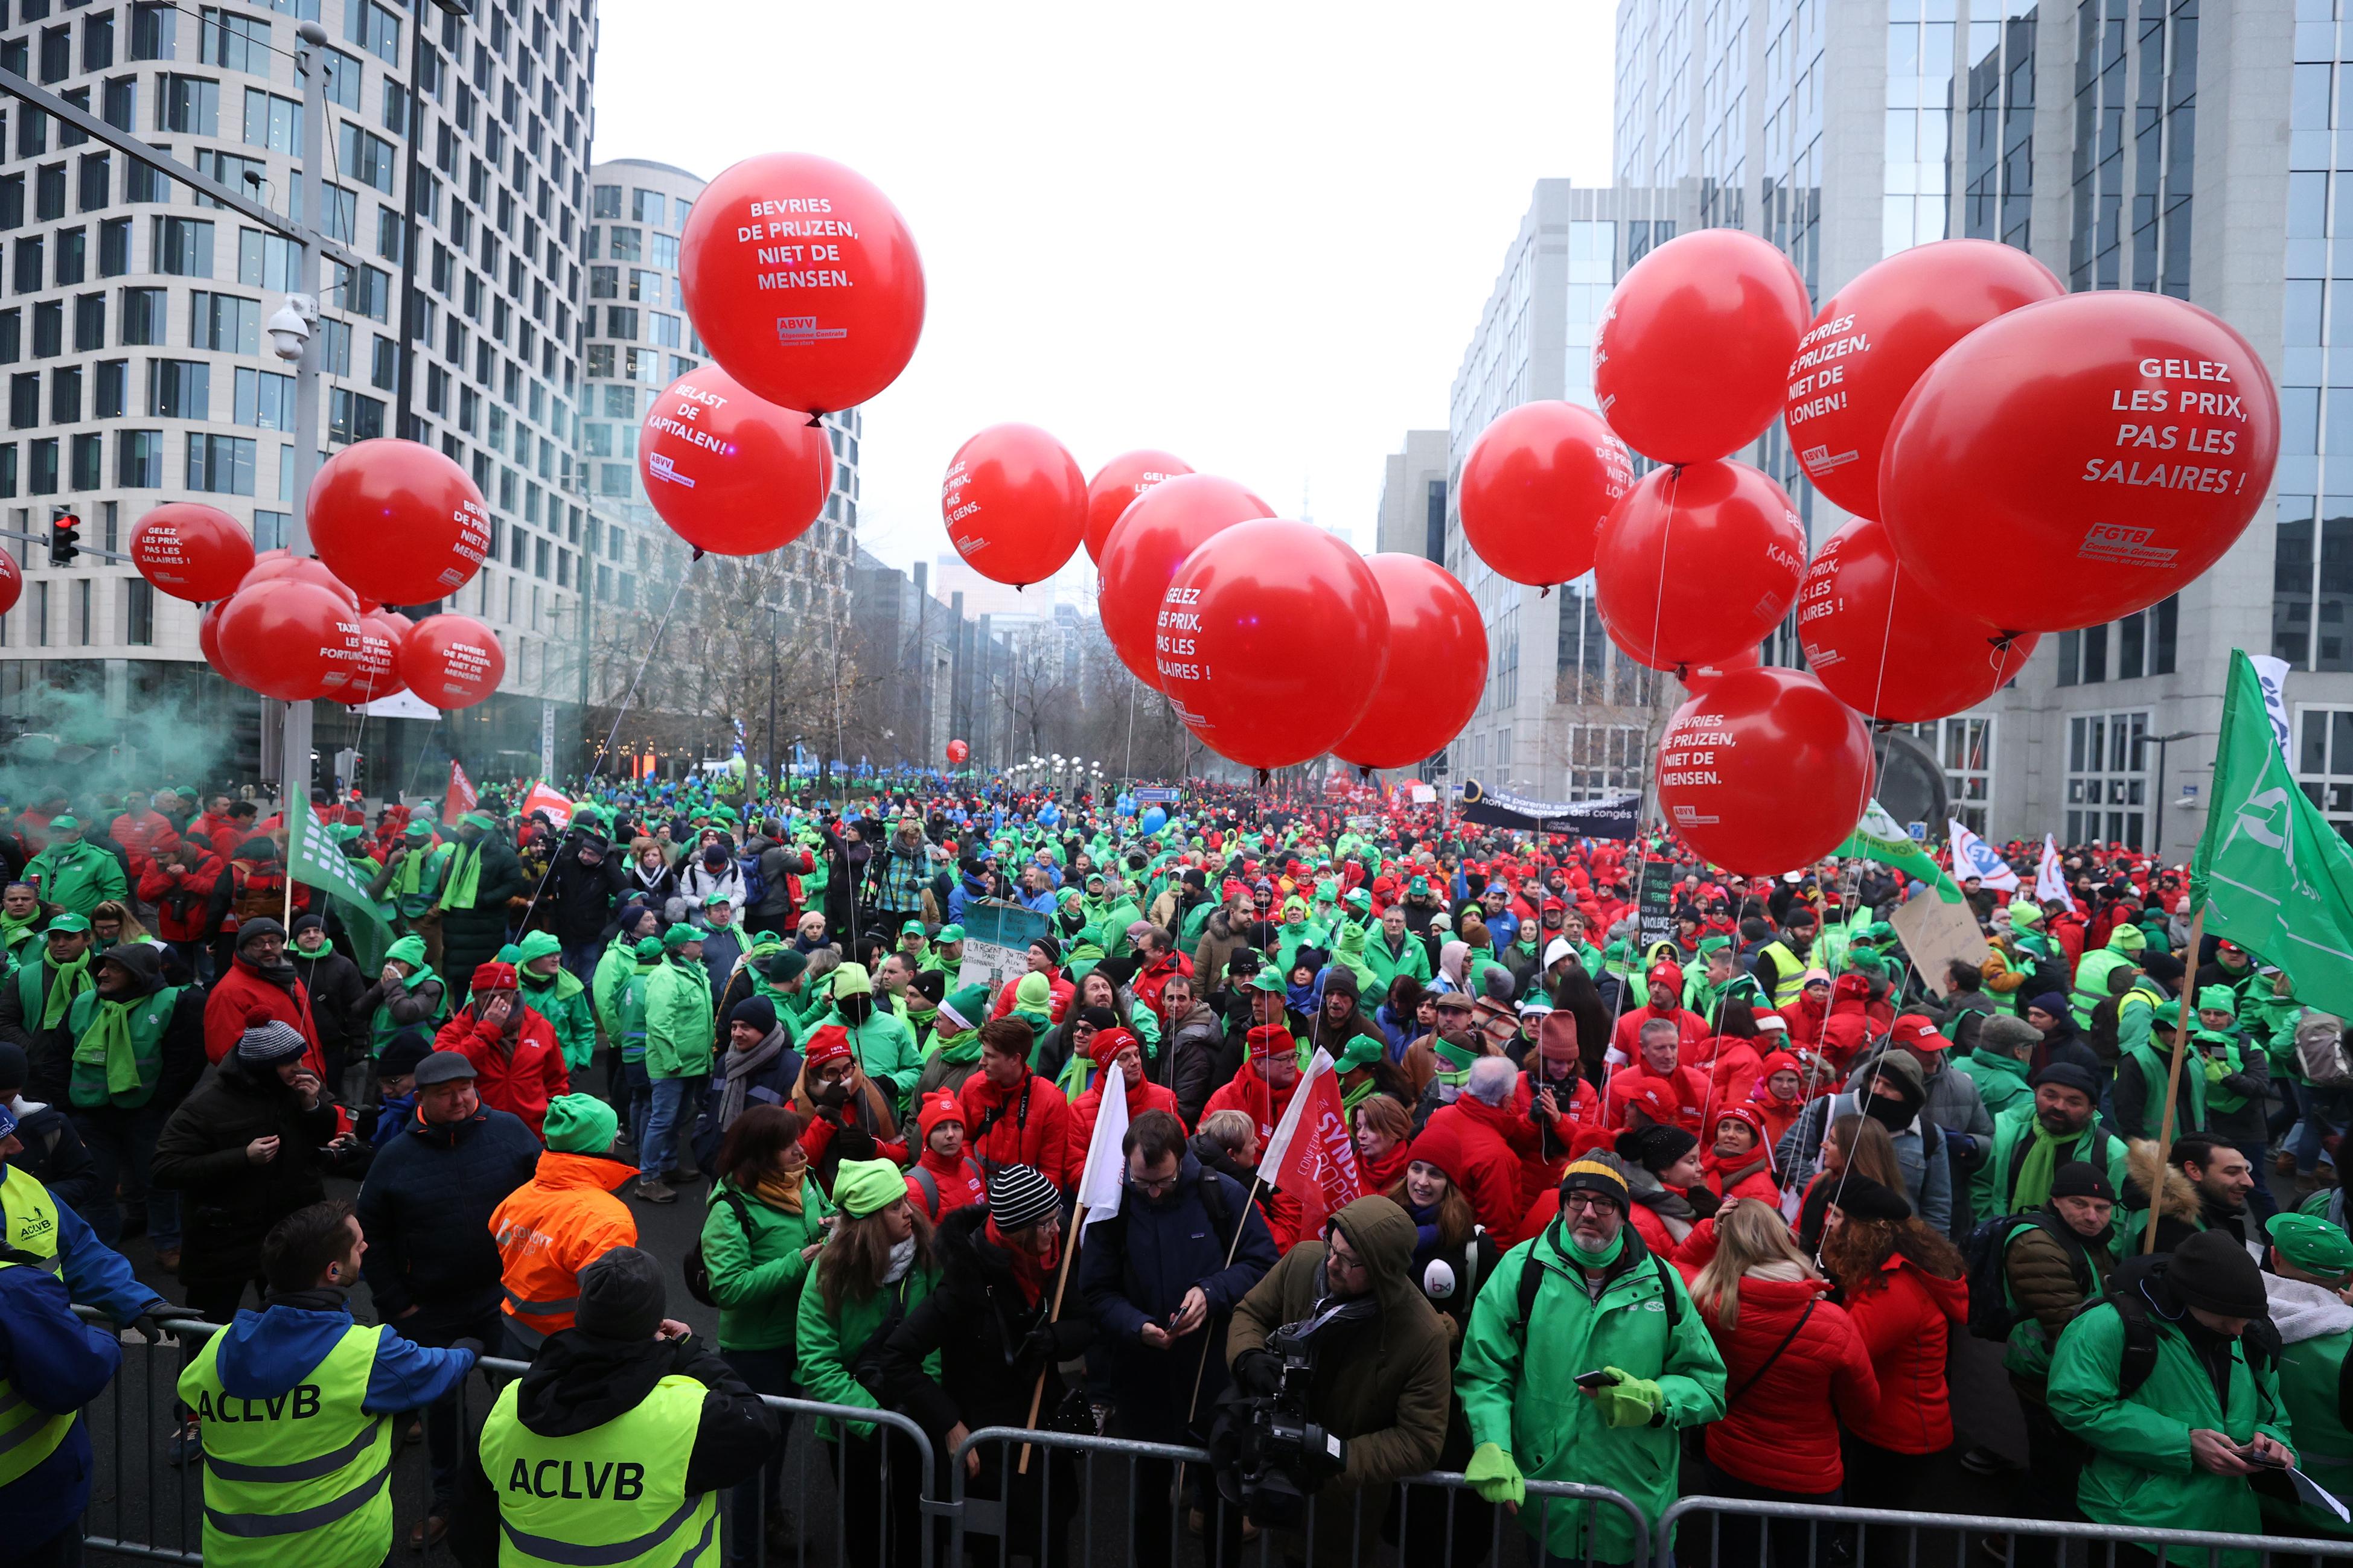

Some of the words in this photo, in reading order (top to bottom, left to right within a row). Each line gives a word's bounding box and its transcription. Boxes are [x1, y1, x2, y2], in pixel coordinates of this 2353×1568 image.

[750, 199, 831, 217] BEVRIES
[738, 224, 764, 243] DE
[768, 220, 858, 240] PRIJZEN,
[758, 245, 804, 264] NIET
[811, 244, 840, 261] DE
[758, 270, 853, 290] MENSEN.
[779, 319, 813, 329] ABVV
[1798, 313, 1856, 352] BEVRIES
[1797, 334, 1871, 374] PRIJZEN,
[2139, 358, 2231, 383] GELEZ
[1789, 375, 1815, 402] NIET
[1818, 365, 1844, 389] DE
[674, 384, 727, 409] BELAST
[677, 403, 700, 421] DE
[1789, 390, 1848, 426] LONEN!
[2112, 390, 2169, 412] LES
[2179, 391, 2248, 422] PRIX,
[648, 415, 727, 456] KAPITALEN!
[2116, 424, 2179, 450] PAS
[2187, 428, 2238, 455] LES
[651, 454, 671, 469] ABVV
[1596, 447, 1612, 461] DE
[1804, 446, 1826, 462] ABVV
[949, 473, 972, 491] PRIX,
[1607, 465, 1628, 484] NIET
[2082, 458, 2232, 494] SALAIRES
[2235, 473, 2246, 495] !
[947, 492, 961, 509] PAS
[454, 511, 470, 526] DE
[953, 501, 982, 521] GENS.
[148, 527, 177, 535] GELEZ
[461, 529, 482, 546] NIET
[2090, 525, 2150, 543] FGTB
[158, 537, 183, 546] PRIX,
[2085, 542, 2128, 555] Centrale
[2130, 547, 2173, 559] Générale
[142, 555, 184, 564] SALAIRES
[1810, 558, 1840, 580] PRIX,
[1166, 587, 1201, 605] GELEZ
[1810, 579, 1831, 599] LES
[1158, 611, 1169, 628] LES
[1169, 612, 1203, 634] PRIX,
[346, 637, 359, 647] LES
[362, 636, 389, 648] GELEZ
[452, 642, 487, 657] BEVRIES
[1157, 640, 1170, 655] PAS
[1172, 639, 1196, 656] LES
[442, 649, 456, 658] DE
[449, 659, 469, 670] NIET
[470, 665, 482, 674] DE
[1671, 715, 1724, 731] BEVRIES
[1673, 732, 1737, 748] PRIJZEN,
[1664, 753, 1690, 767] NIET
[1693, 751, 1714, 765] DE
[1663, 771, 1722, 786] MENSEN.
[1481, 797, 1501, 808] non
[1502, 803, 1518, 812] au
[1518, 806, 1569, 818] rabotage
[1571, 807, 1591, 818] des
[1592, 809, 1632, 820] congés
[1494, 789, 1511, 802] Les
[1513, 796, 1552, 810] parents
[1547, 823, 1580, 833] familles
[1651, 892, 1670, 903] FEMMES
[1641, 916, 1670, 929] VIOLENCE
[967, 941, 1003, 955] L'ARGENT
[983, 952, 995, 961] PAR
[21, 1219, 51, 1237] ACLVB
[198, 1384, 321, 1424] ACLVB
[509, 1458, 645, 1502] ACLVB
